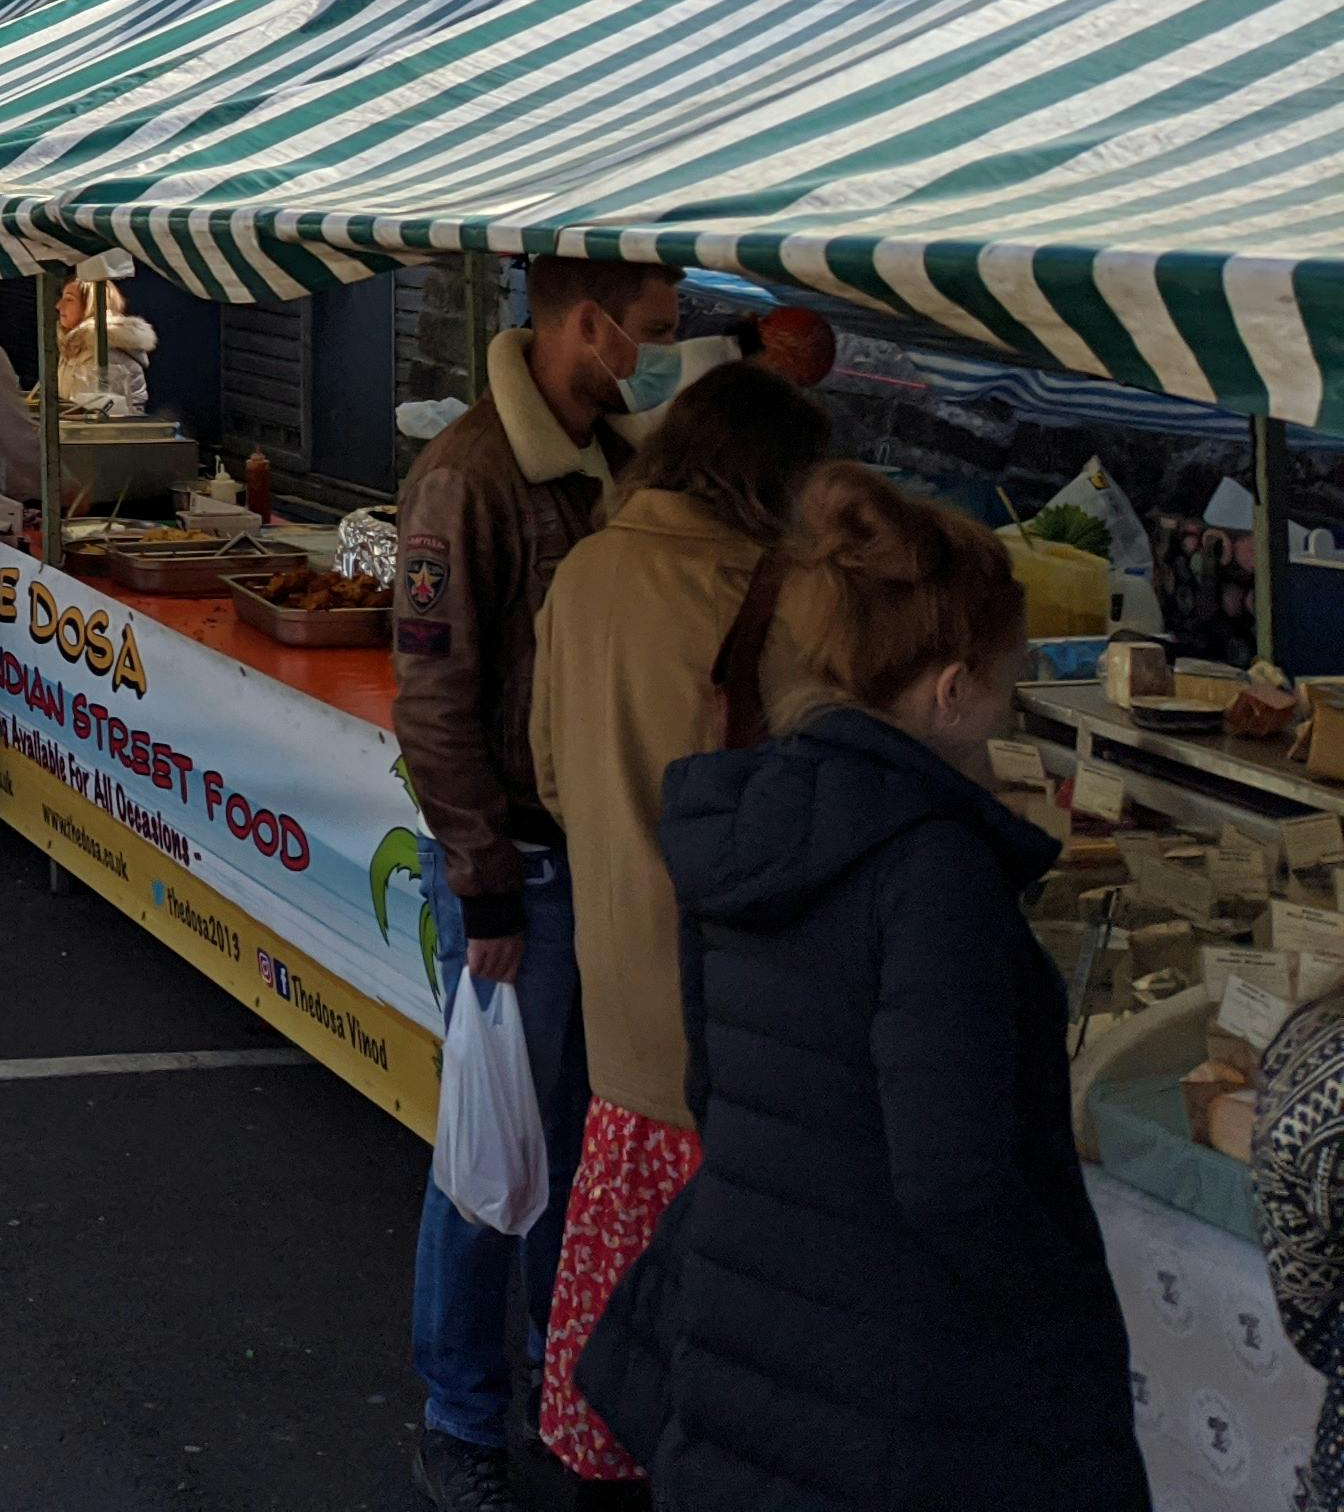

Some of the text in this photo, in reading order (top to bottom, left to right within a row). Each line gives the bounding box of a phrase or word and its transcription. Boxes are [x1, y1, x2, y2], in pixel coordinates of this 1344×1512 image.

[28, 581, 147, 700] DOSA
[12, 714, 67, 782] Available
[68, 752, 91, 797] For
[94, 768, 114, 816] All
[115, 782, 191, 867] Occasions
[72, 692, 194, 804] STREET
[203, 770, 310, 872] FOOD
[41, 802, 389, 1072] www.thedosa.co.uk thedosa2013 Thedosa Vinod
